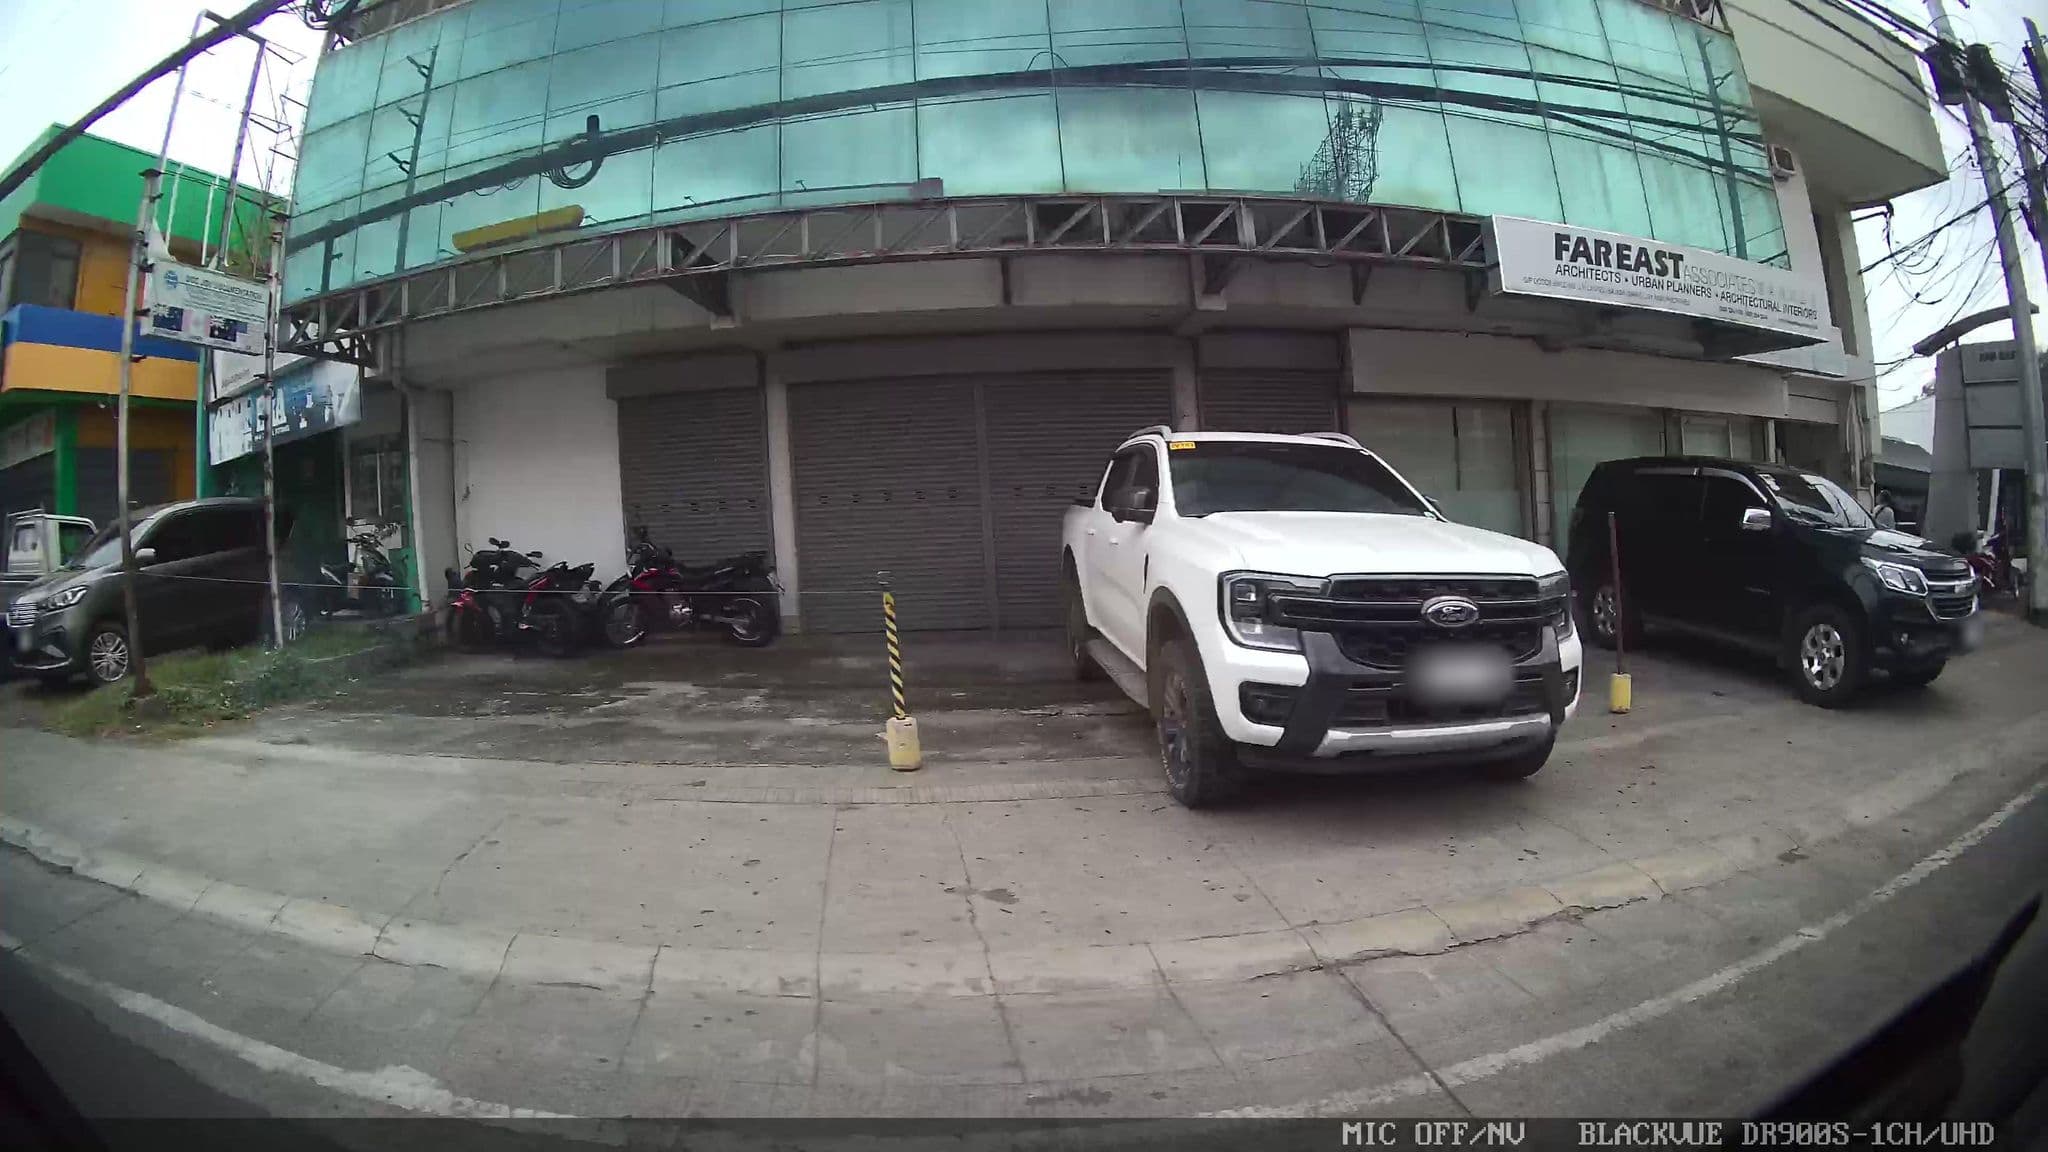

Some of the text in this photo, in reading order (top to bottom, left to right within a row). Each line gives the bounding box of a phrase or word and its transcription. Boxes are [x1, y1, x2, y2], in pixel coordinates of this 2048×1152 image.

[1555, 263, 1621, 284] ARCHITECTS
[1631, 275, 1665, 291] URBAN
[1666, 280, 1712, 299] PLANNERS
[1720, 290, 1782, 313] ARCHITECTURAL
[1782, 303, 1818, 321] INTERIORS
